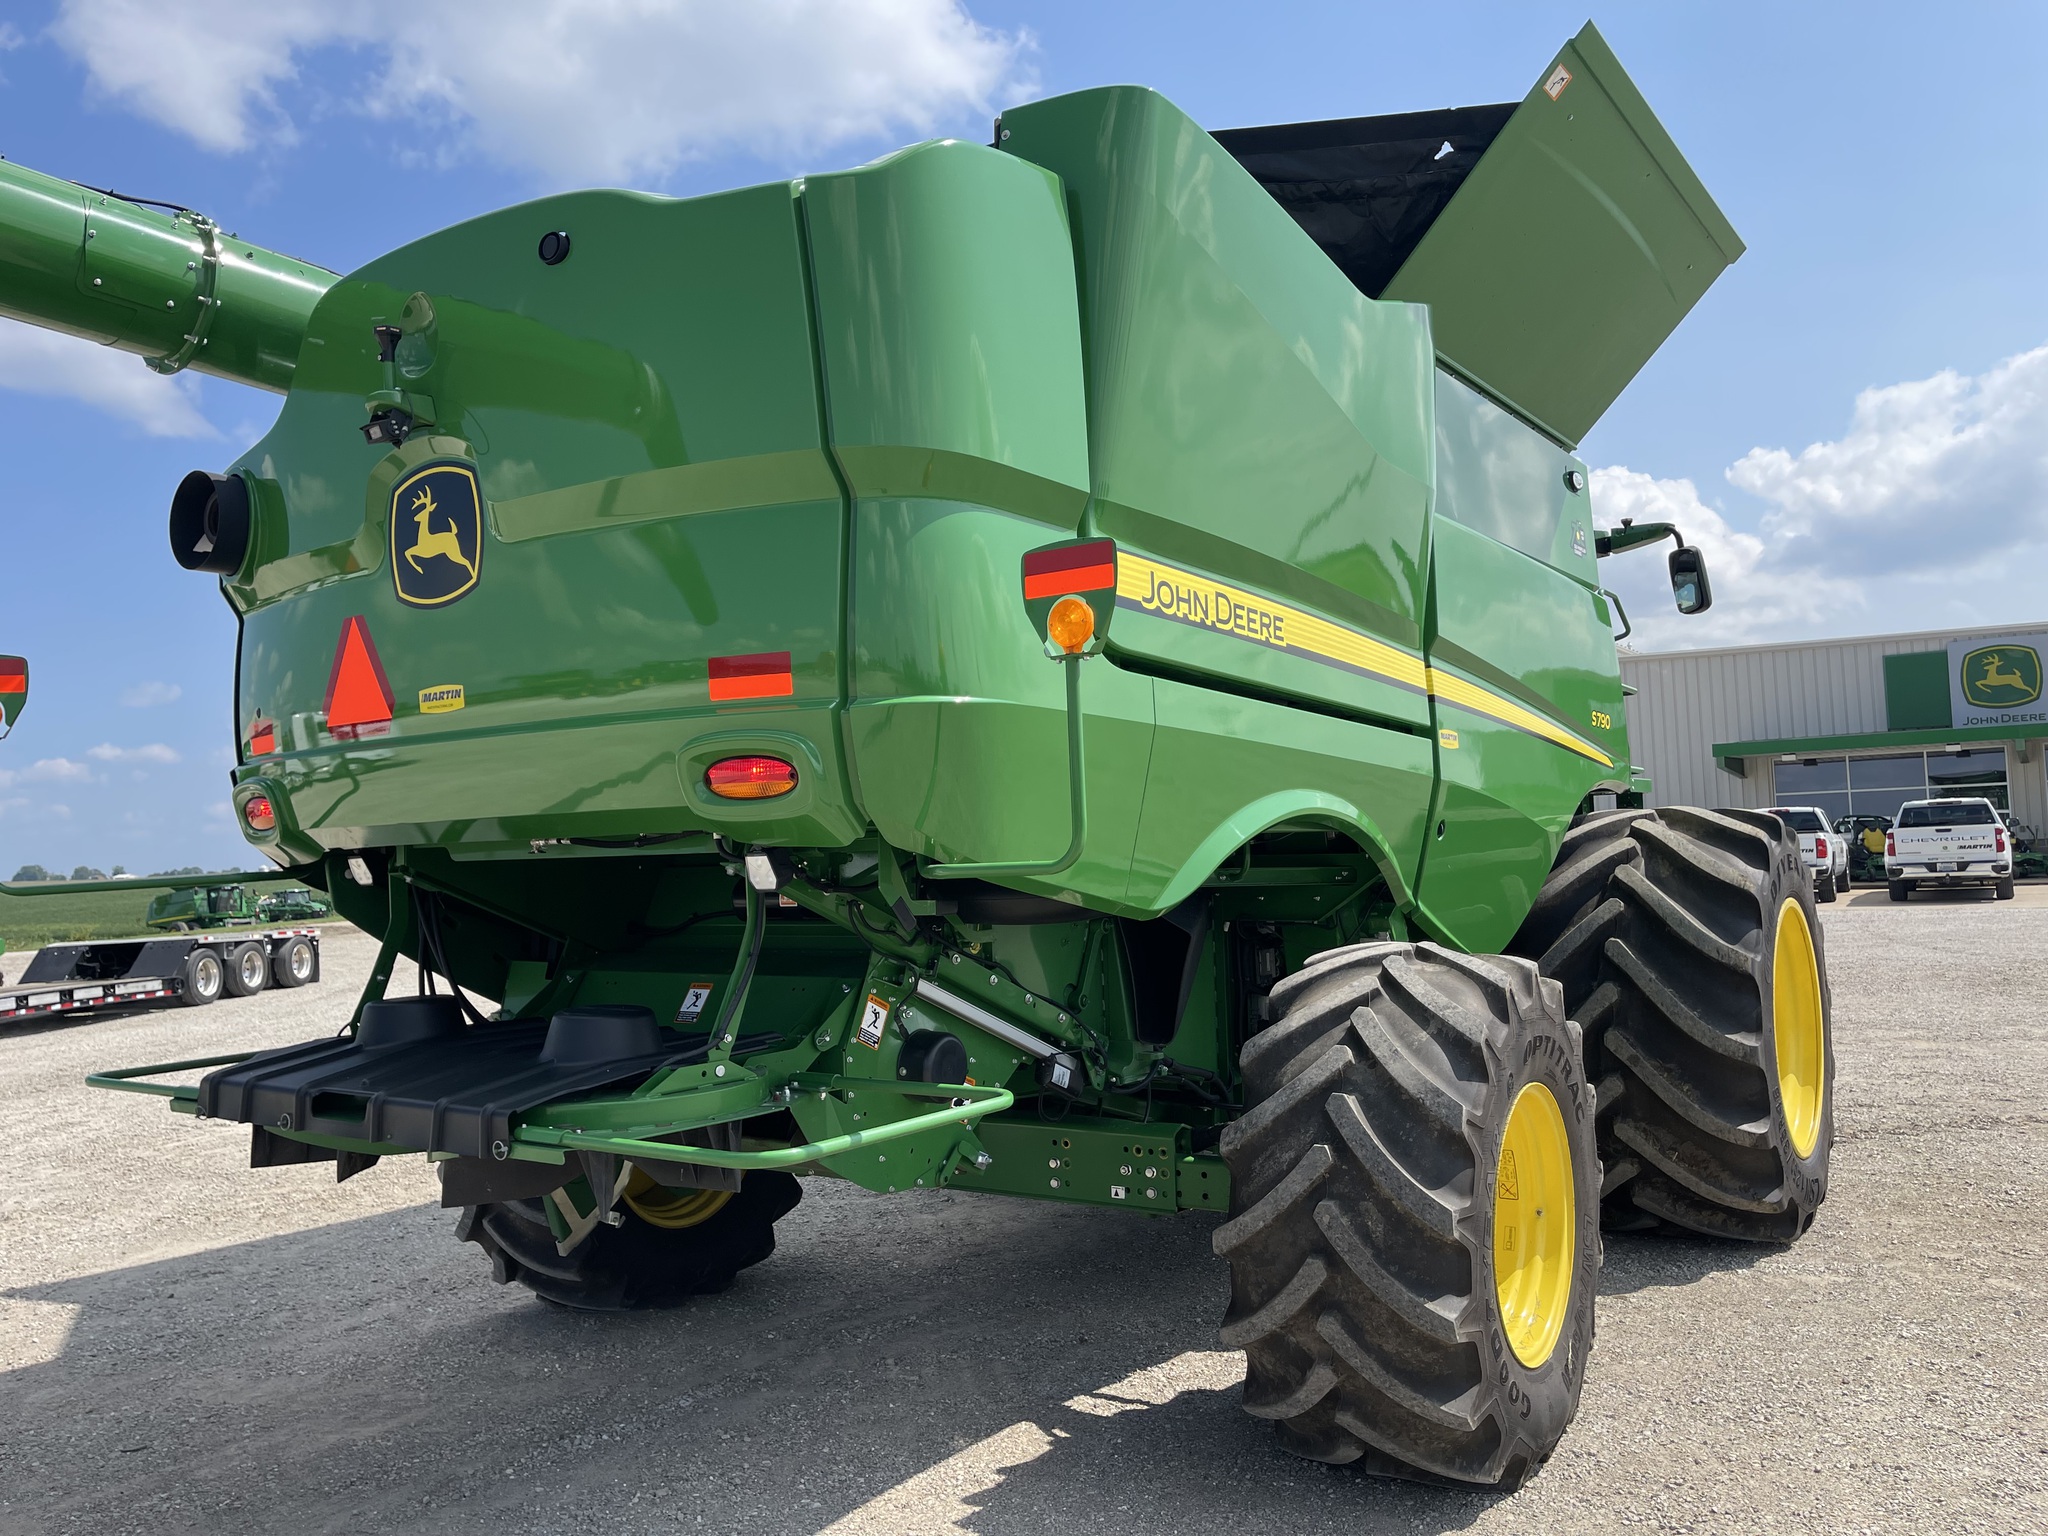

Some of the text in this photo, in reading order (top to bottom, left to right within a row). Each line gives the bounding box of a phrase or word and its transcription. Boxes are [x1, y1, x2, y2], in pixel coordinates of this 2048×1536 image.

[1141, 570, 1286, 643] JOHN DEERE
[421, 689, 462, 703] MARTIN
[1591, 710, 1611, 730] S790
[1962, 712, 2047, 726] JOHN DEERE
[1901, 835, 1988, 844] CHEVROLET
[1523, 1034, 1585, 1125] OPTITRAC
